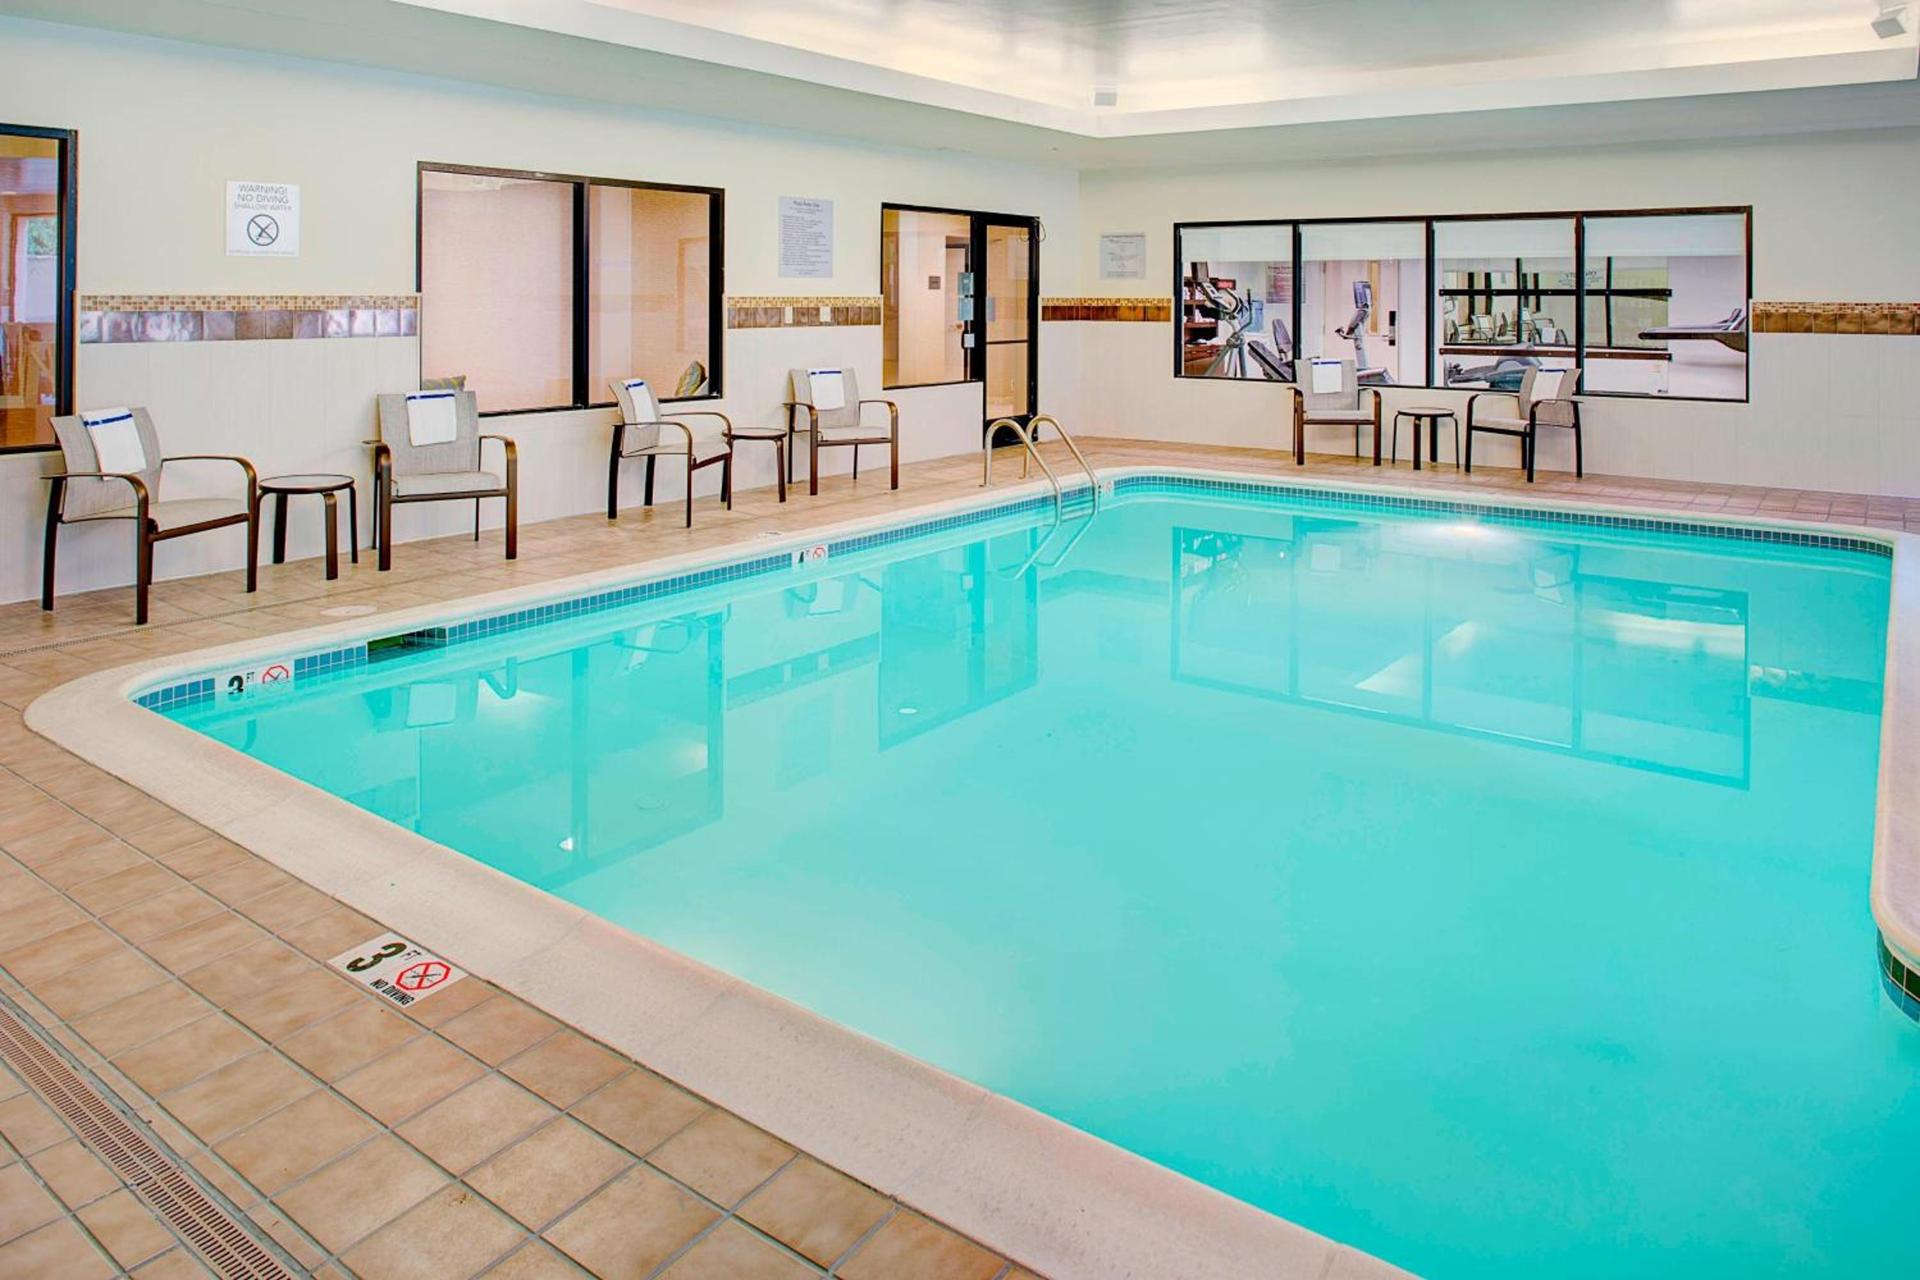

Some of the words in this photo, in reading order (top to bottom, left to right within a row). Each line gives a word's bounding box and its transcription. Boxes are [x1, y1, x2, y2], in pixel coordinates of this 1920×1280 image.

[237, 193, 254, 202] NO
[256, 194, 289, 204] DIVING
[346, 942, 407, 972] 3
[400, 949, 422, 961] FT
[370, 978, 389, 990] NO
[382, 986, 414, 1005] DIVING
